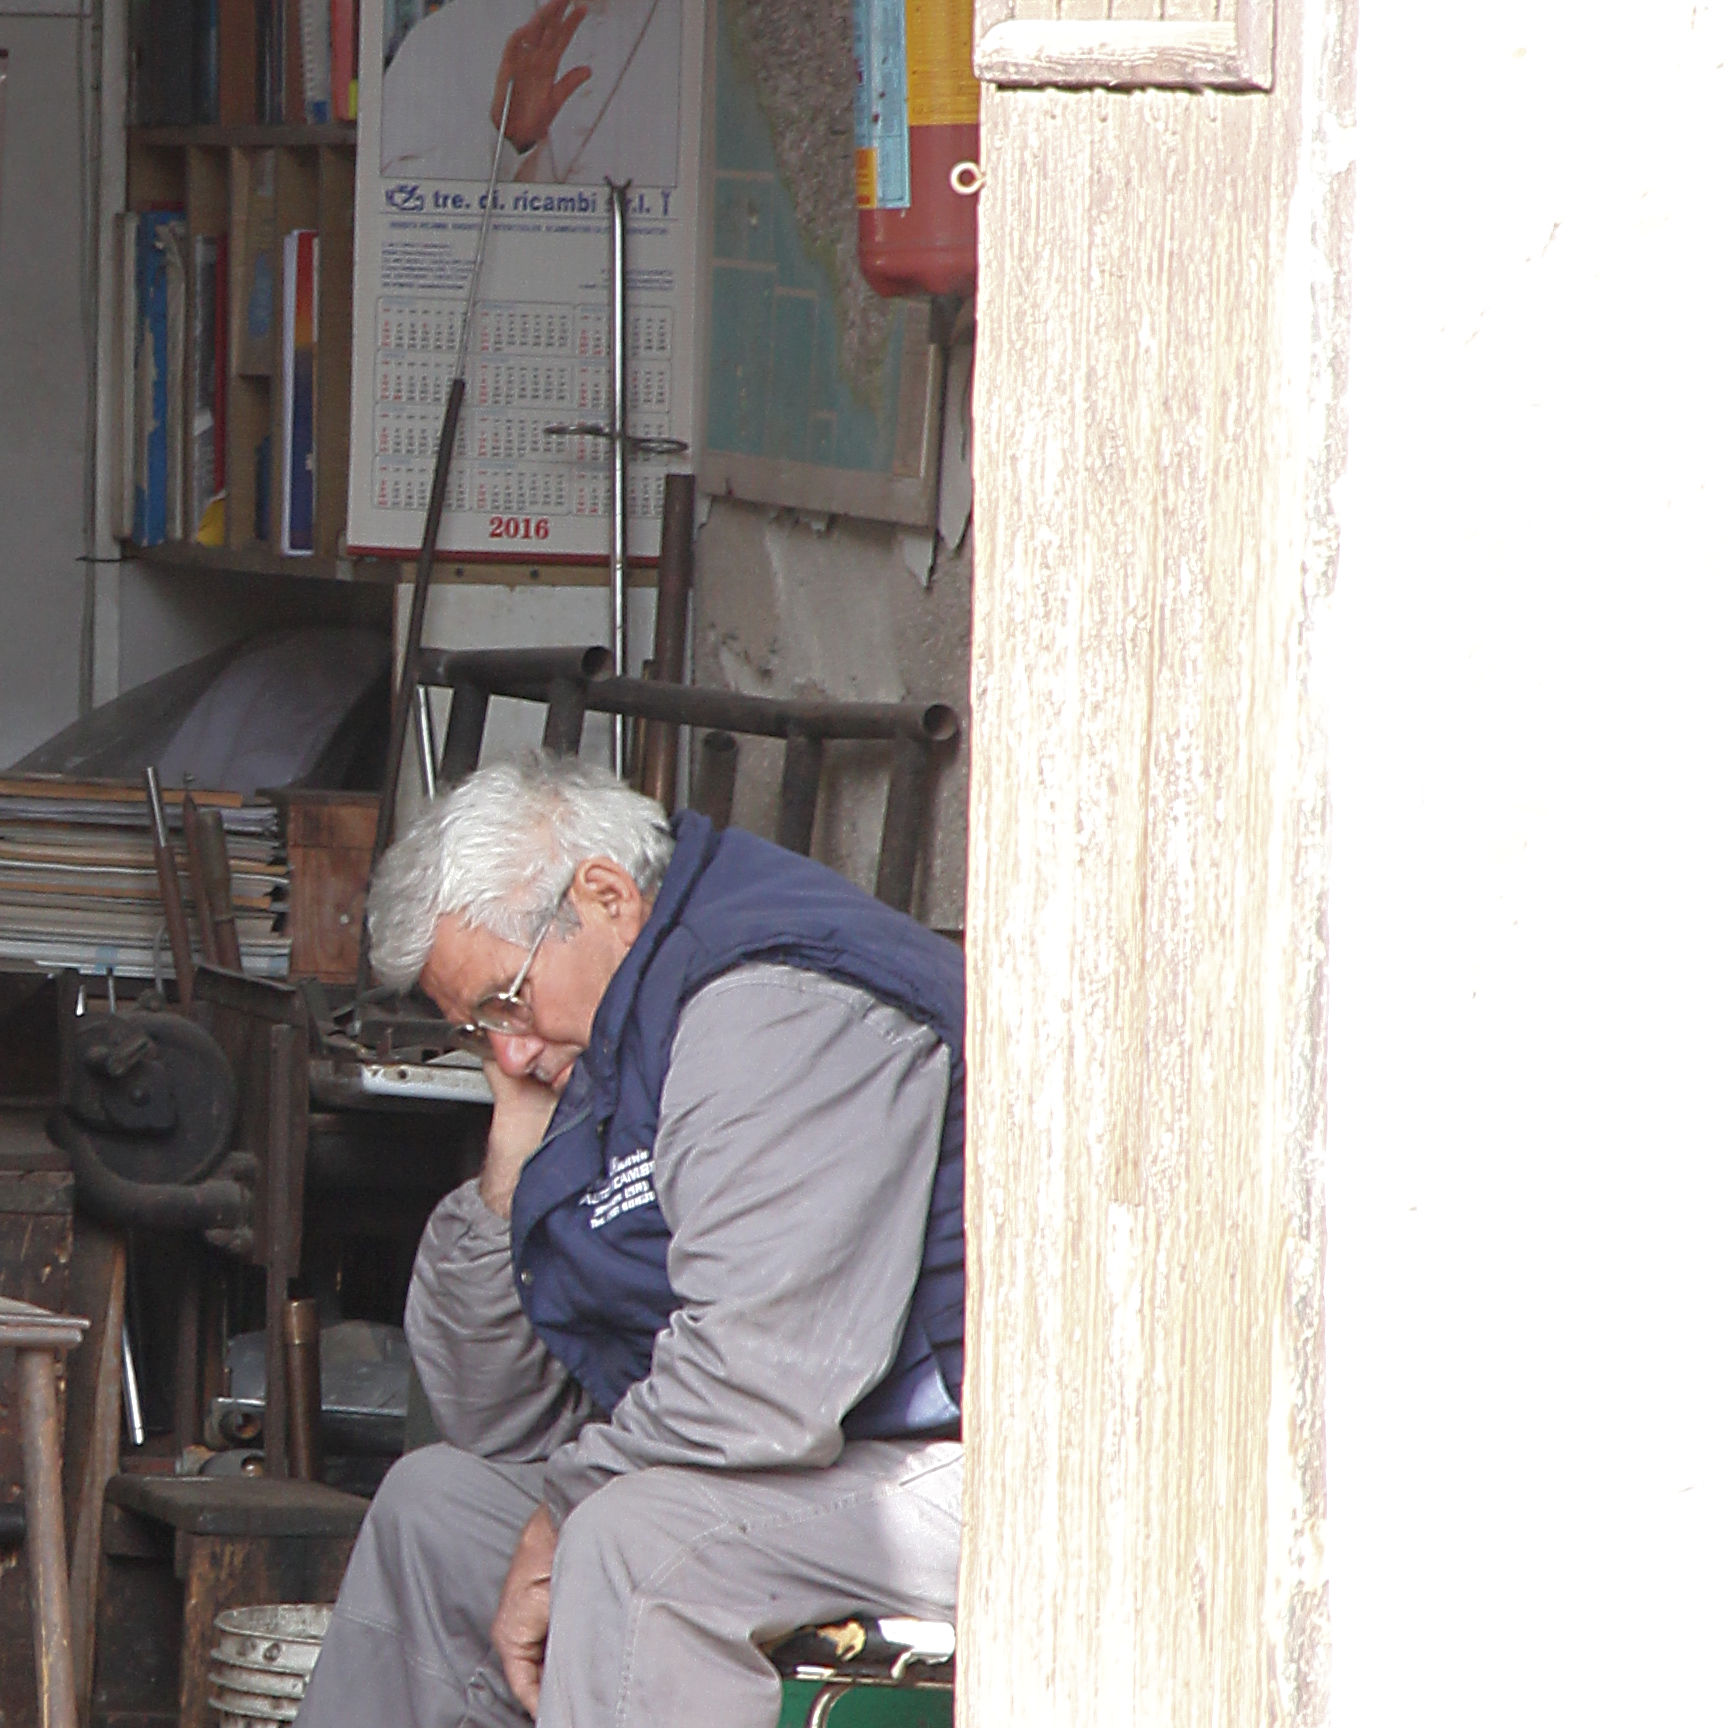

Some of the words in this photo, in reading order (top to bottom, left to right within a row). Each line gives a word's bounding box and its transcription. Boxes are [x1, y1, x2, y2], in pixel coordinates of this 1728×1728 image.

[433, 190, 471, 210] tre.
[513, 191, 597, 213] ricambi
[488, 515, 550, 540] 2016
